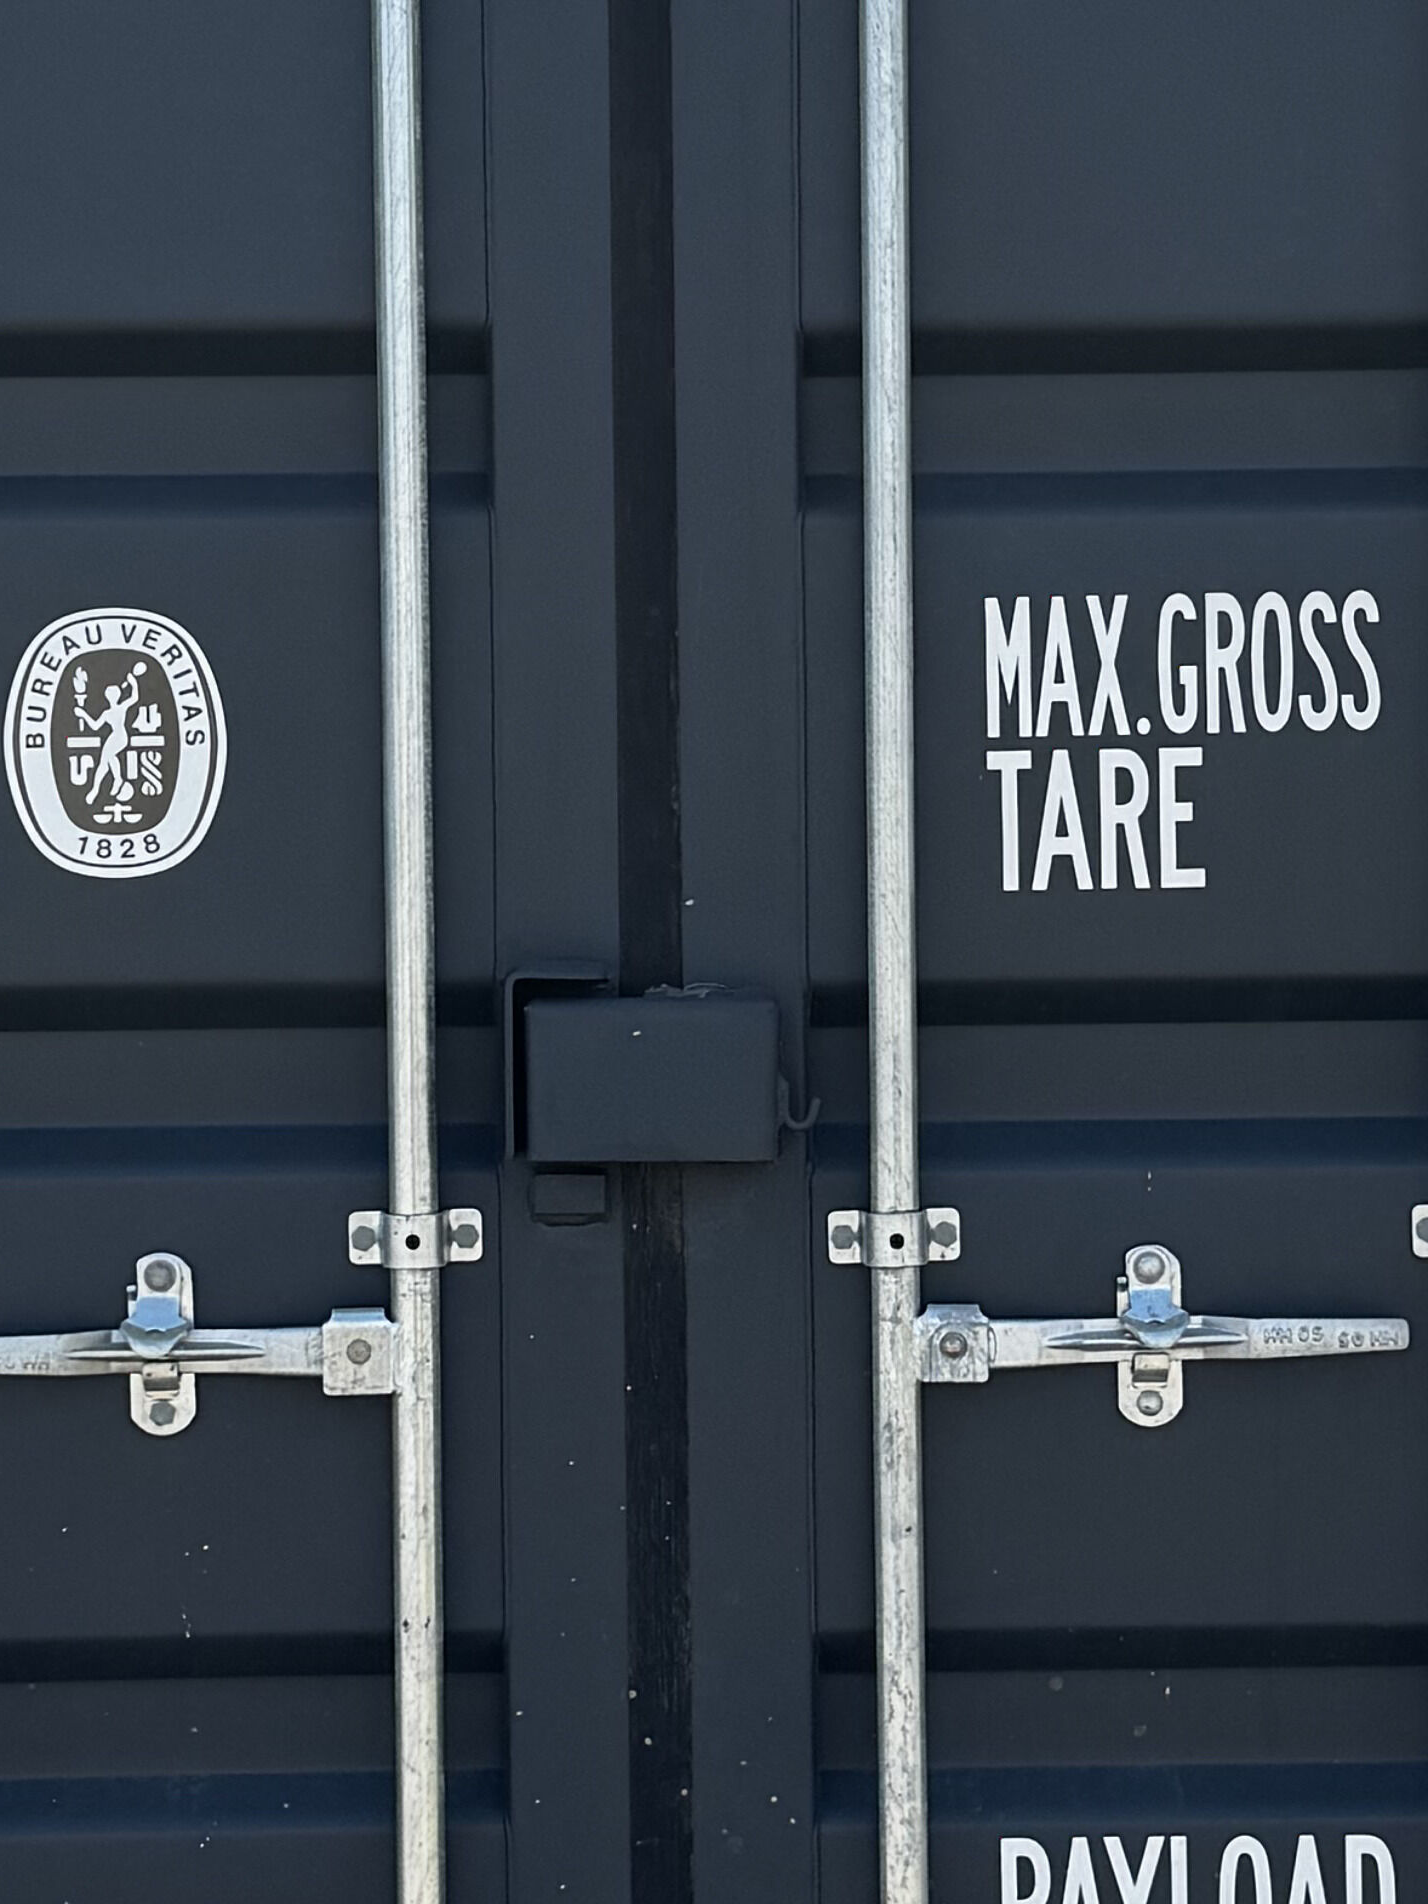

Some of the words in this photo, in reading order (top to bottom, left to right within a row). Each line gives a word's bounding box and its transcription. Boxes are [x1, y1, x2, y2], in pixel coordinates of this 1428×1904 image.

[26, 624, 103, 749] BUREAU
[121, 623, 206, 746] VERITAS
[77, 833, 161, 859] 1828
[987, 747, 1205, 891] TARE
